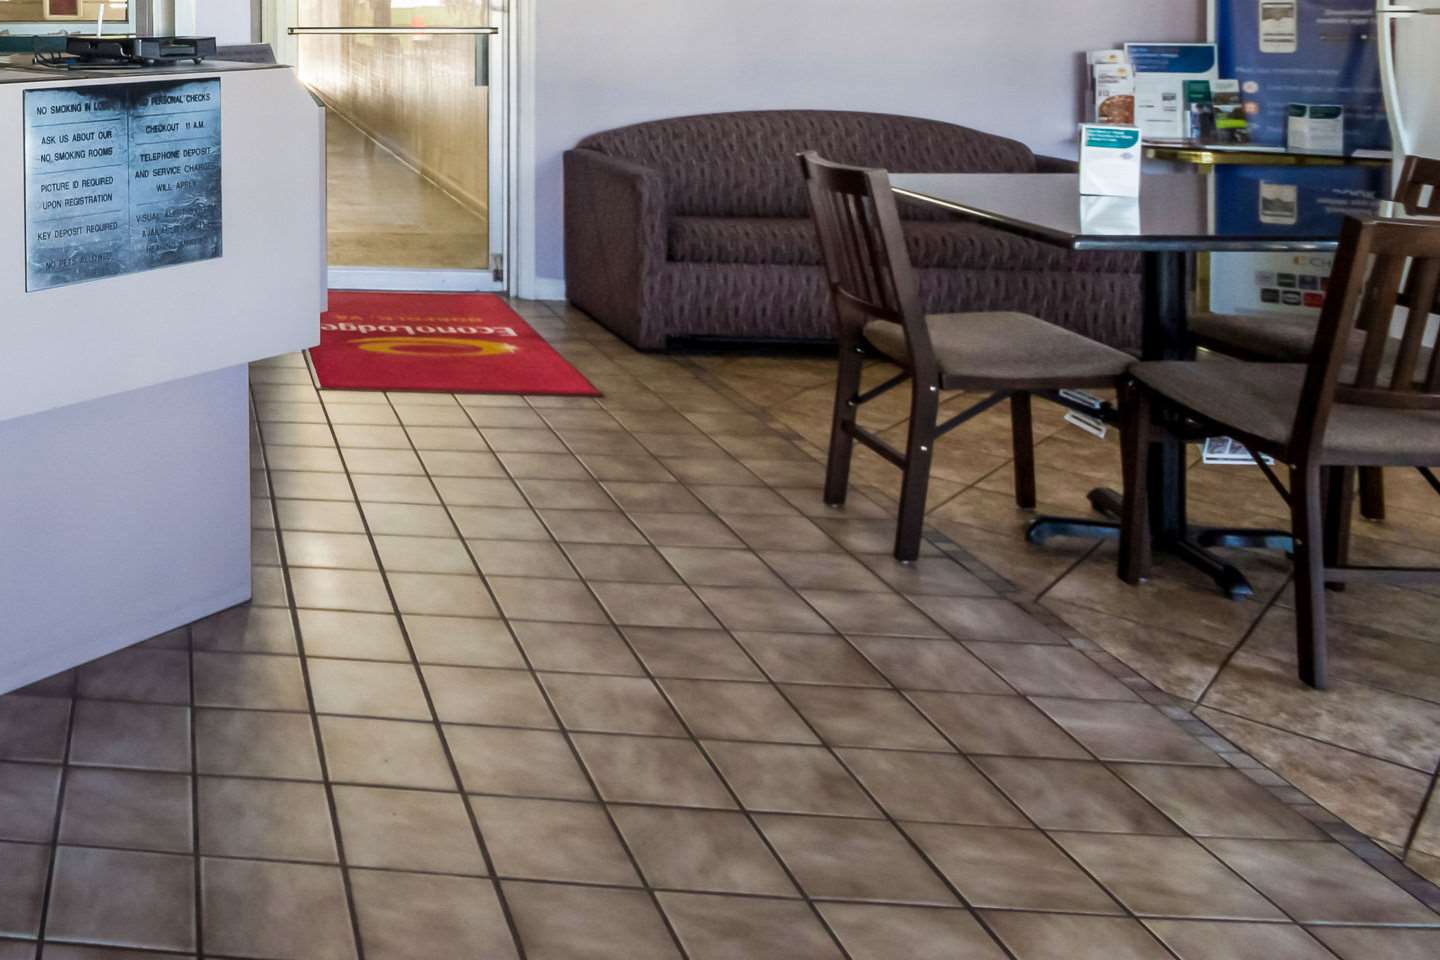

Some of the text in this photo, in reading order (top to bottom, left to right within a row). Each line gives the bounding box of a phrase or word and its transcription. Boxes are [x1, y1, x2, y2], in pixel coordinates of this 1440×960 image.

[151, 92, 211, 106] PERSONAL CHECKS
[36, 102, 92, 116] NO SMOKING IN
[145, 122, 179, 135] CHECKOUT
[41, 129, 112, 145] ASK US ABOUT OUR
[40, 146, 113, 163] NO SMOKING ROOMS
[140, 146, 211, 163] TELEPHONE DEPOSIT
[135, 168, 149, 179] AND
[152, 165, 182, 177] SERVICE
[40, 176, 114, 193] PICTURE ID REQUIRED
[156, 182, 172, 193] WILL
[42, 193, 113, 210] UPON REGISTRATION
[37, 221, 118, 241] KEY DEPOSIT REQUIRED
[321, 322, 518, 337] EconoLodge
